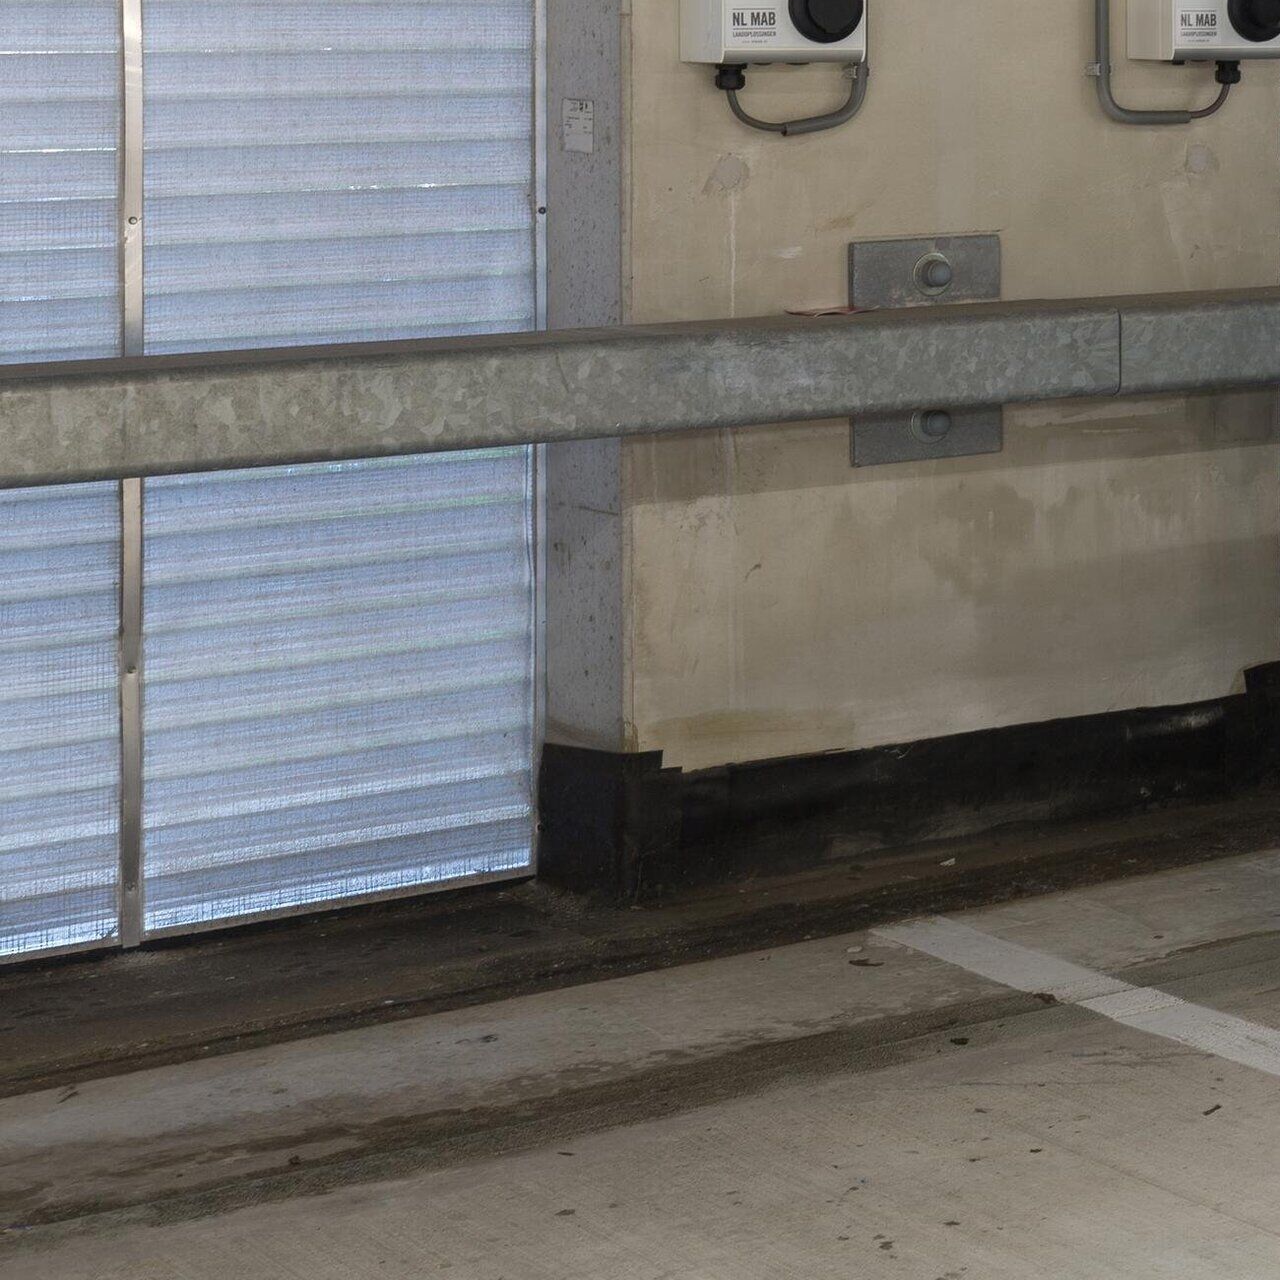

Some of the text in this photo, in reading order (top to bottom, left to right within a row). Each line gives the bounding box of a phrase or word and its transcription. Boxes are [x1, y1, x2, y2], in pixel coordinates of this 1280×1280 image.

[732, 11, 776, 26] NL MAB
[1180, 13, 1217, 27] NL MAB
